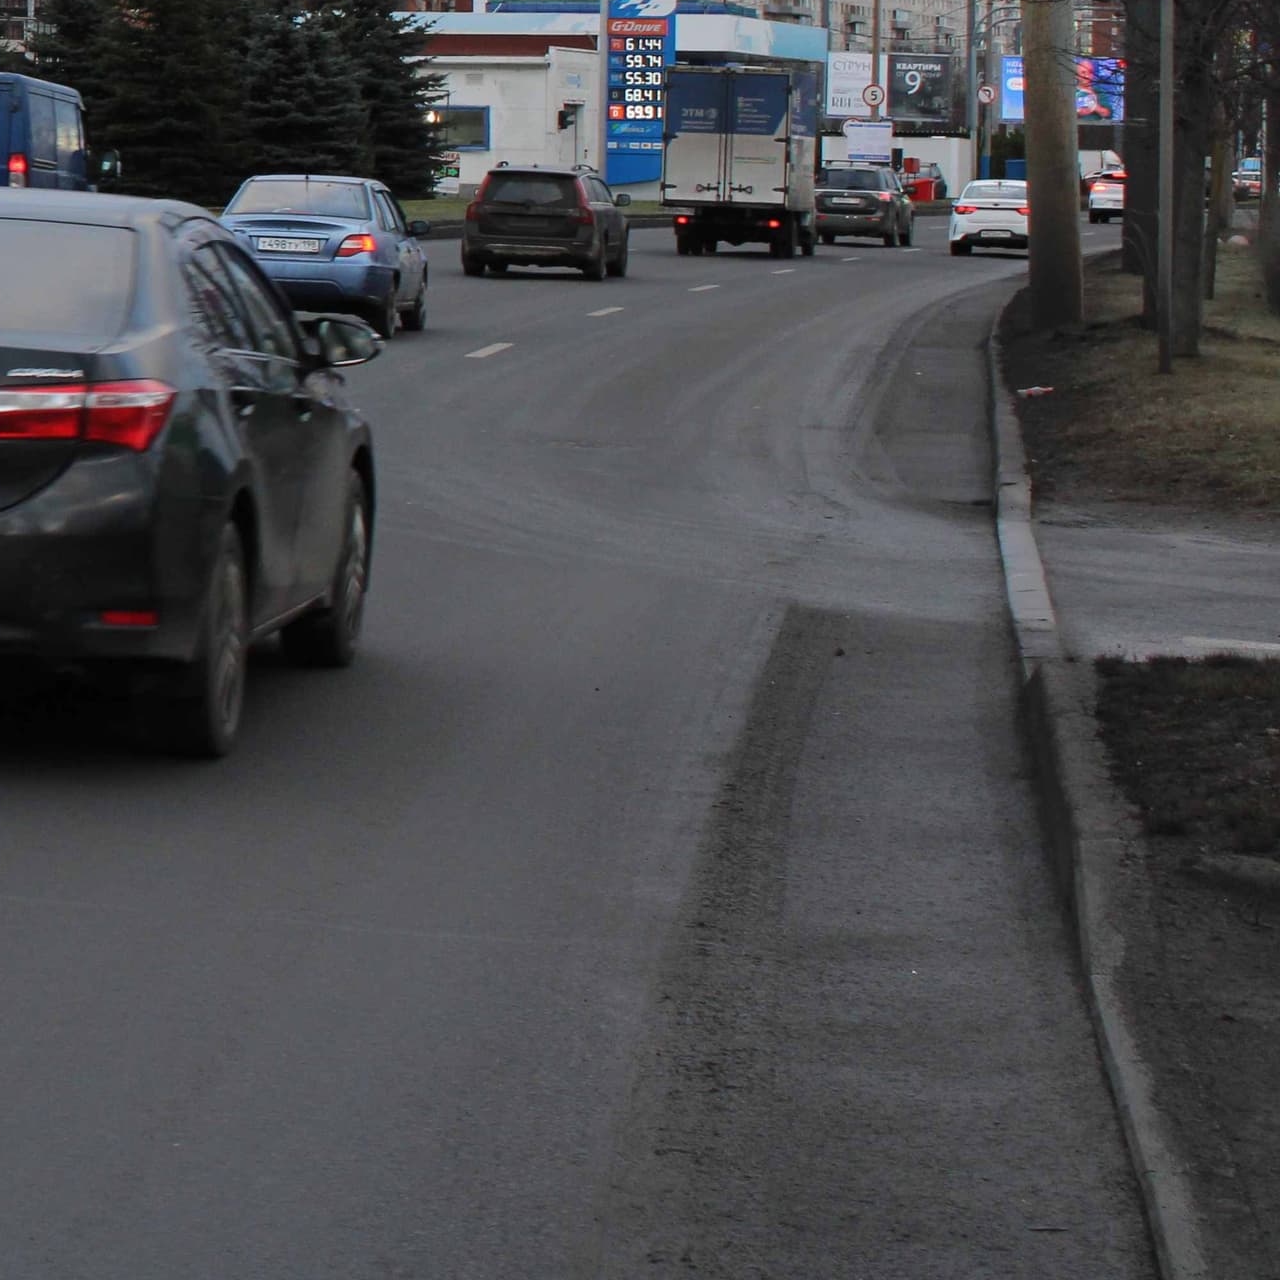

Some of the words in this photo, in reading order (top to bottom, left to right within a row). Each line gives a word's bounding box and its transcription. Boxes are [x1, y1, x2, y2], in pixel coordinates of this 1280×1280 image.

[626, 38, 661, 51] 61.44
[626, 54, 661, 68] 59.74
[625, 71, 661, 85] 55.30
[625, 88, 661, 101] 68.41
[870, 90, 877, 101] 5
[626, 105, 662, 119] 69.91
